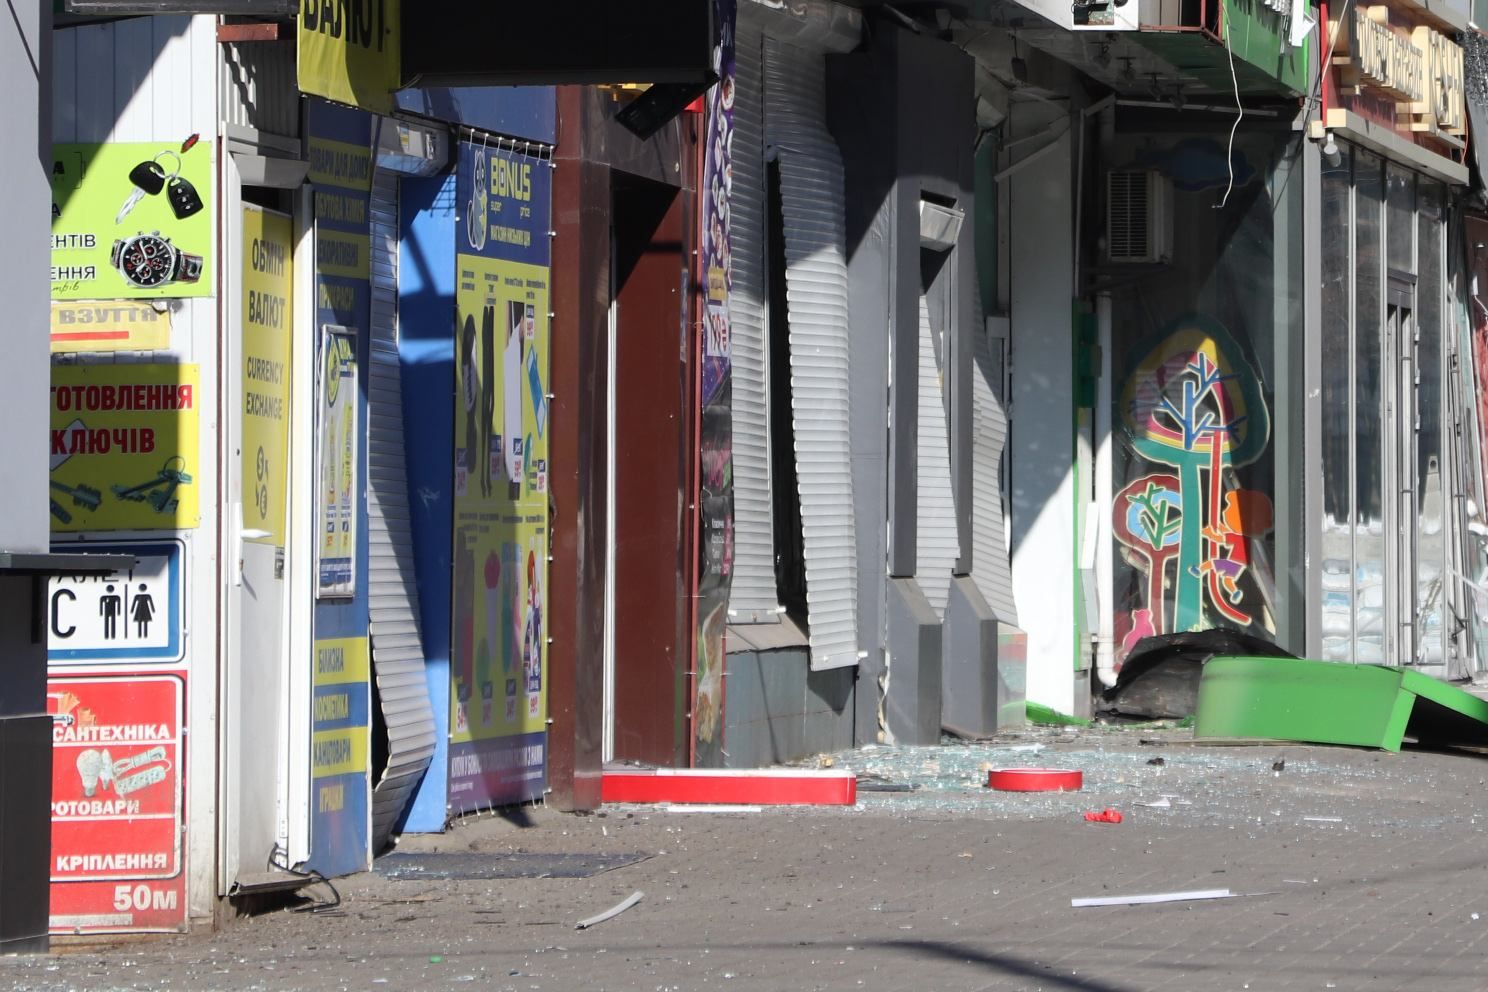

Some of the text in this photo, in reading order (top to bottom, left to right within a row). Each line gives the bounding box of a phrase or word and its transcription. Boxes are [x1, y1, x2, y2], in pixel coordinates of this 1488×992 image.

[490, 157, 531, 201] BONUS
[252, 238, 285, 277] ОБМІН
[59, 308, 158, 325] ВЗУТТЯ
[249, 290, 285, 329] ВАЛЮТ
[247, 356, 284, 385] CURRENCY
[246, 392, 282, 420] EXCHANGE
[52, 428, 155, 454] КЛЮЧІВ
[53, 724, 170, 742] САНТЕХНІКА
[57, 854, 167, 871] КРІПЛЕННЯ
